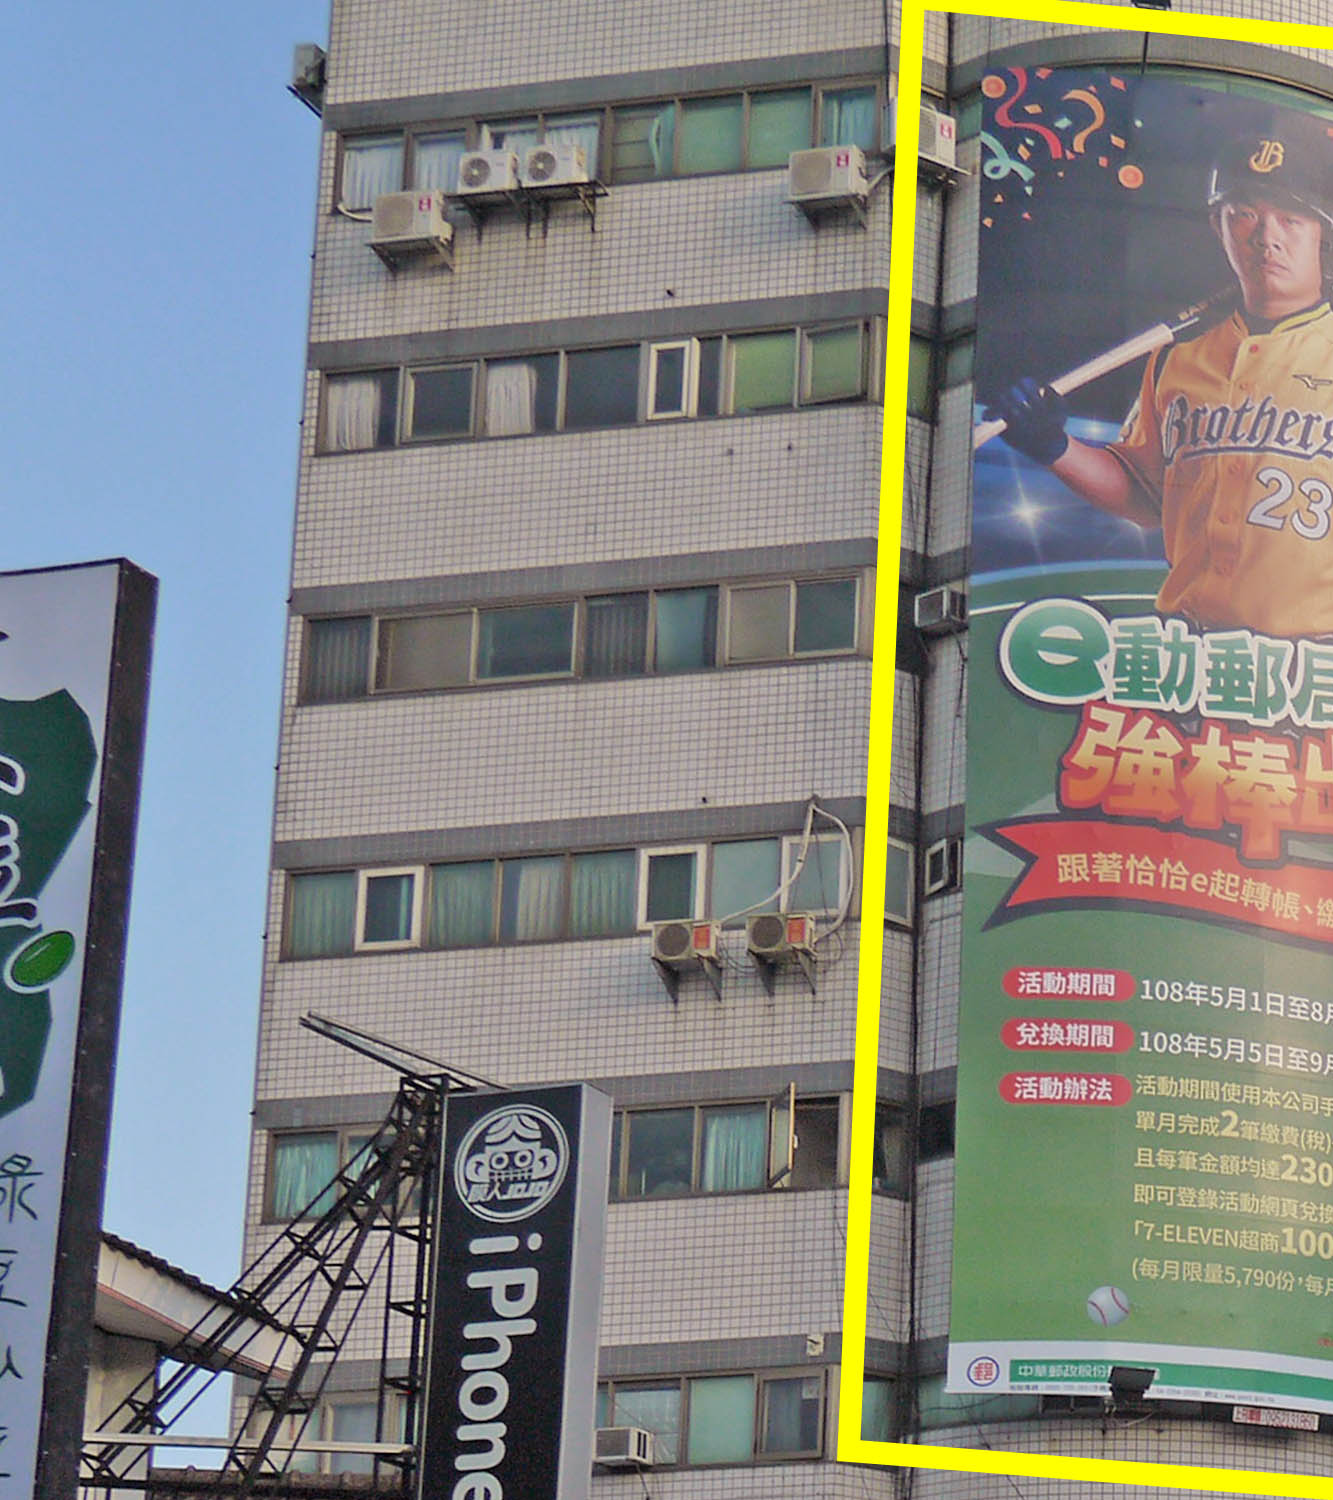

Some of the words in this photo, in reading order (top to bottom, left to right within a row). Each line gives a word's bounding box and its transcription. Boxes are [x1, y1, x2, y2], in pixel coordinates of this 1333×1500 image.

[1018, 971, 1115, 997] 活動期間
[1016, 1023, 1114, 1049] 兌換期間
[1014, 1077, 1113, 1102] 活動辦法
